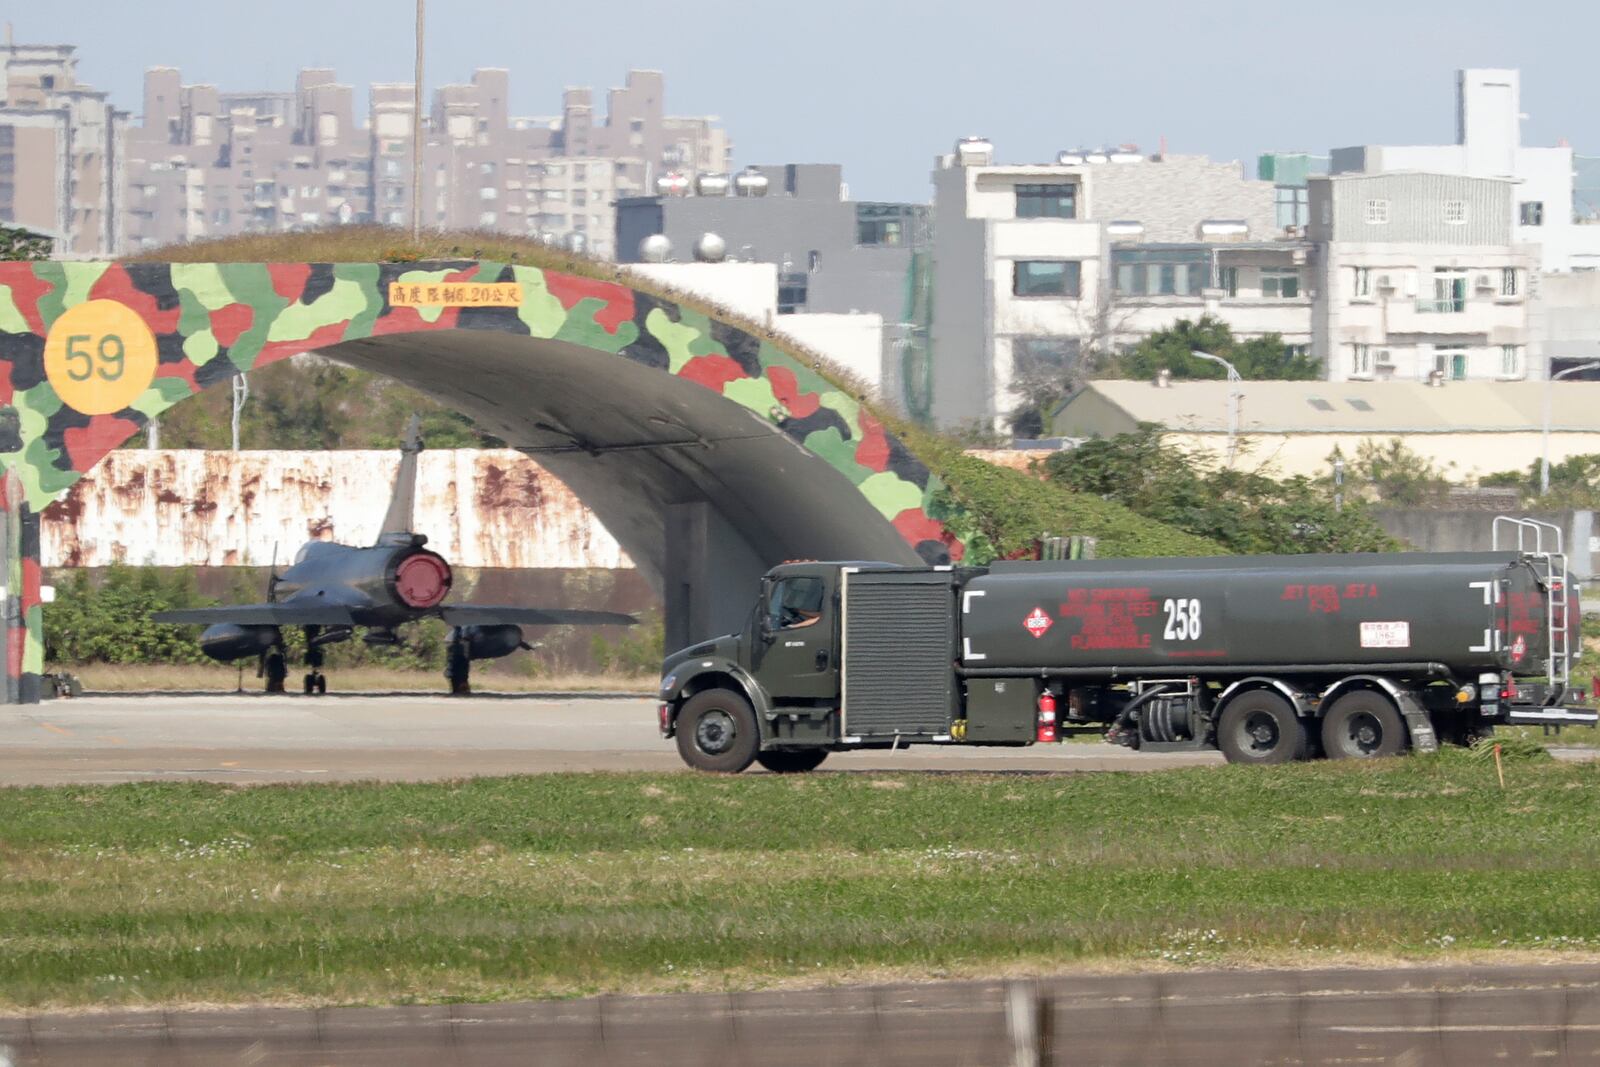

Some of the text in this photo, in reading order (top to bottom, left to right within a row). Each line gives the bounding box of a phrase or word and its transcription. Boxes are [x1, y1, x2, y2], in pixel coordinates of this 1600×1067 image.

[65, 334, 124, 381] 59
[1127, 601, 1158, 616] FEET
[1163, 598, 1202, 641] 258
